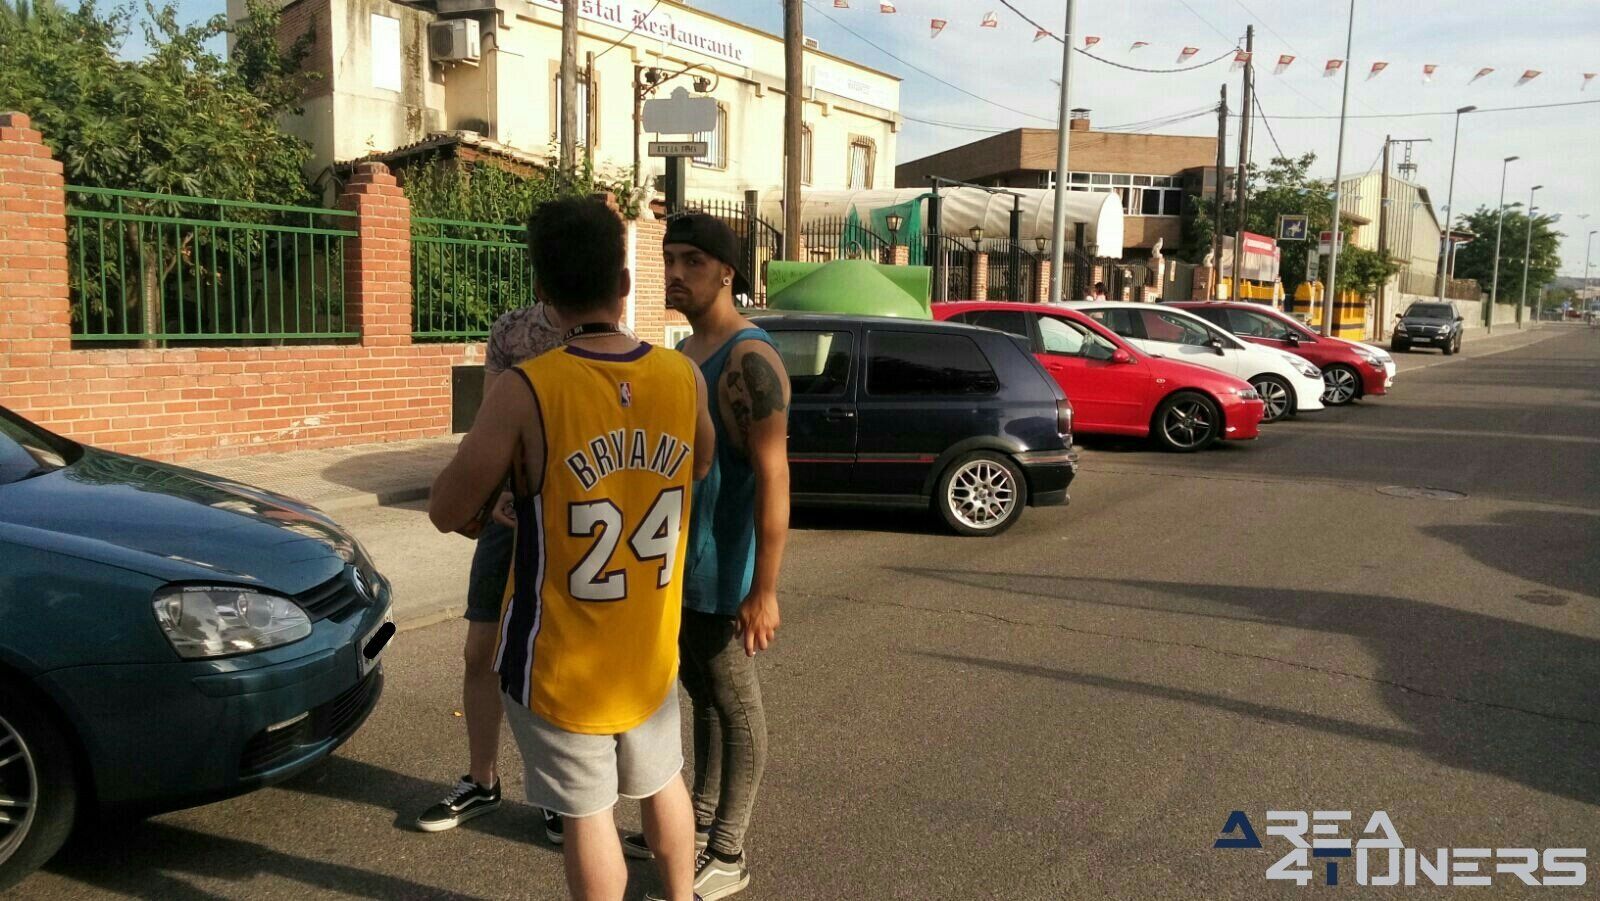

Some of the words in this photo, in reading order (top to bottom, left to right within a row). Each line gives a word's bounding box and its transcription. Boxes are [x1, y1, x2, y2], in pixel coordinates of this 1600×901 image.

[632, 9, 742, 61] Restaurante
[565, 428, 691, 491] BRYANT
[568, 486, 684, 602] 24
